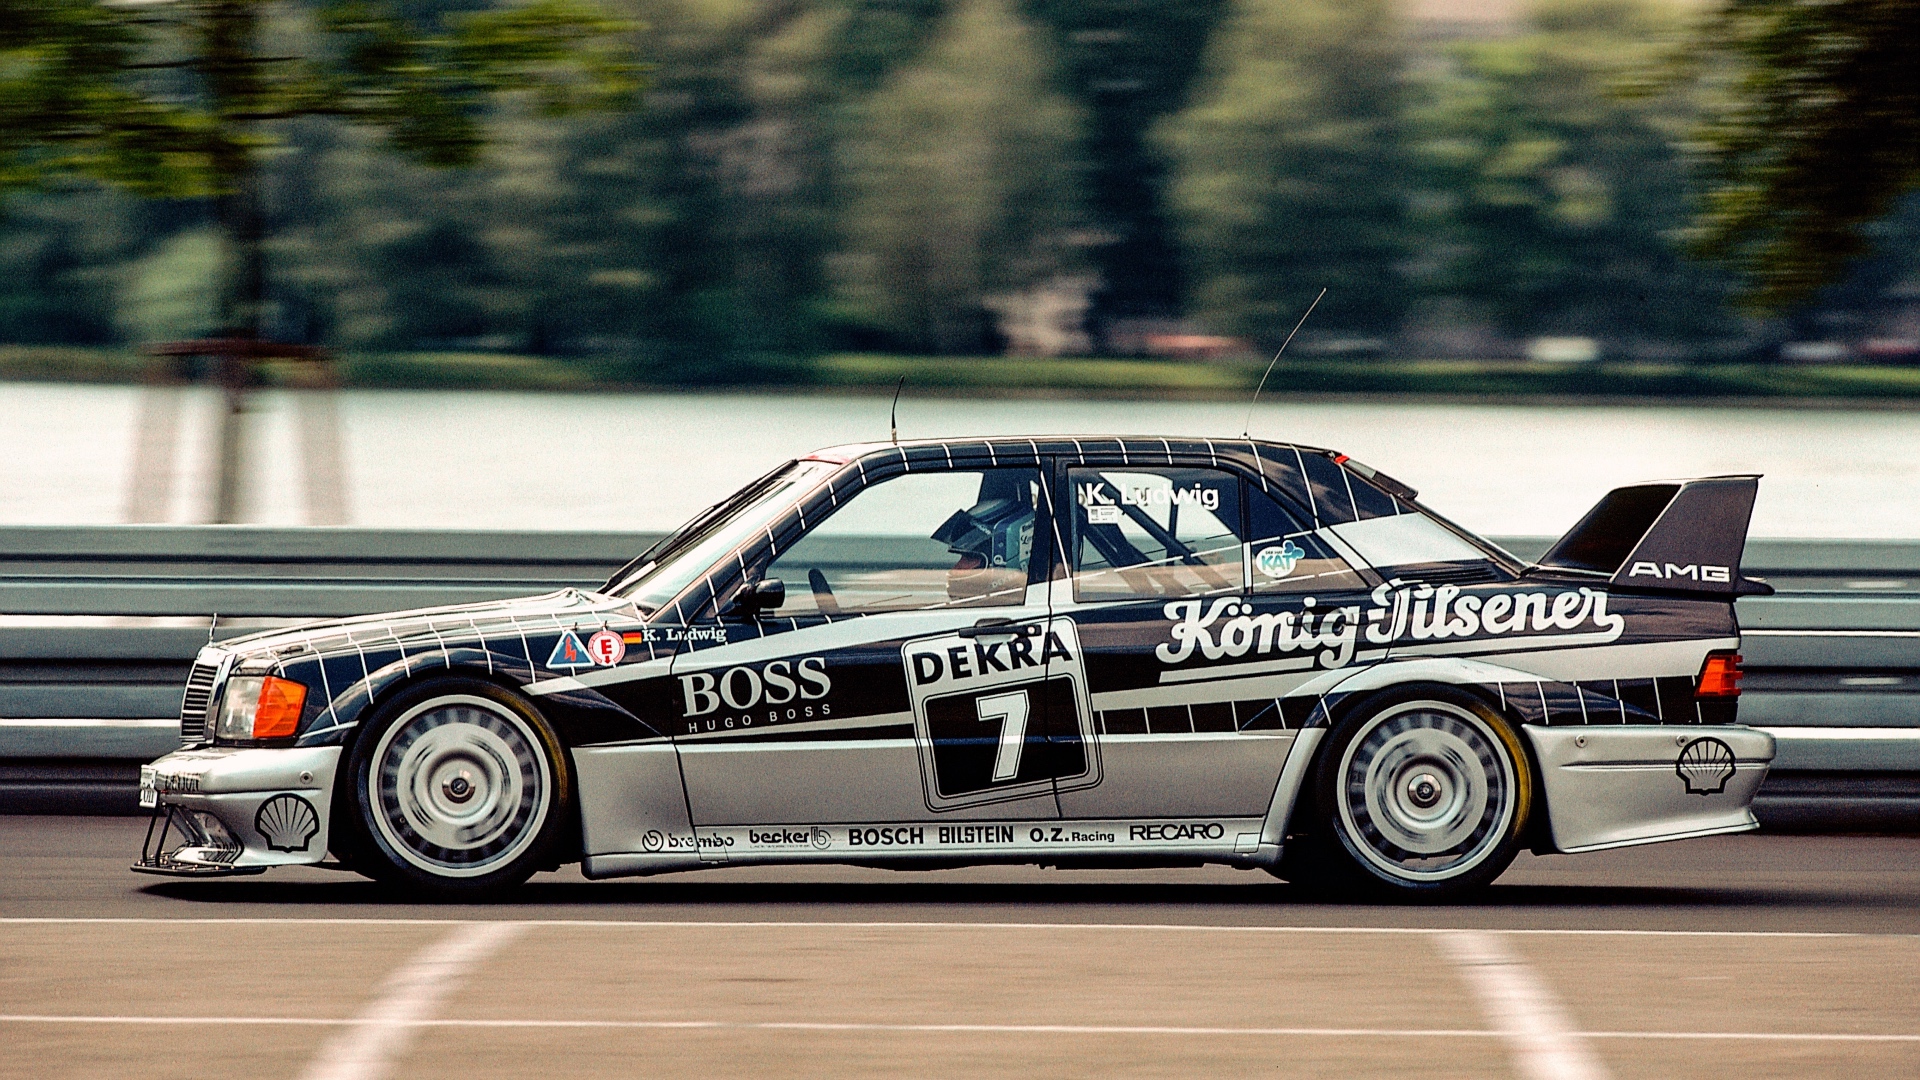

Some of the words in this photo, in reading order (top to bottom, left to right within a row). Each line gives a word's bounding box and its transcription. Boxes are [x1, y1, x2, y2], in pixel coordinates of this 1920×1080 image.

[1086, 482, 1115, 505] K.
[1120, 482, 1219, 511] Ludwig
[1628, 561, 1730, 583] AMG
[642, 628, 661, 642] K.
[912, 631, 1073, 686] DEKRA
[677, 656, 831, 717] BOSS
[688, 714, 752, 733] HUGO
[769, 703, 831, 722] BOSS
[975, 689, 1030, 782] 7
[667, 832, 735, 848] brembo
[749, 828, 810, 844] becker
[848, 826, 924, 846] BOSCH
[938, 825, 1014, 844] BILSTEIN
[1071, 830, 1115, 843] Racing
[1129, 822, 1225, 841] RECARO
